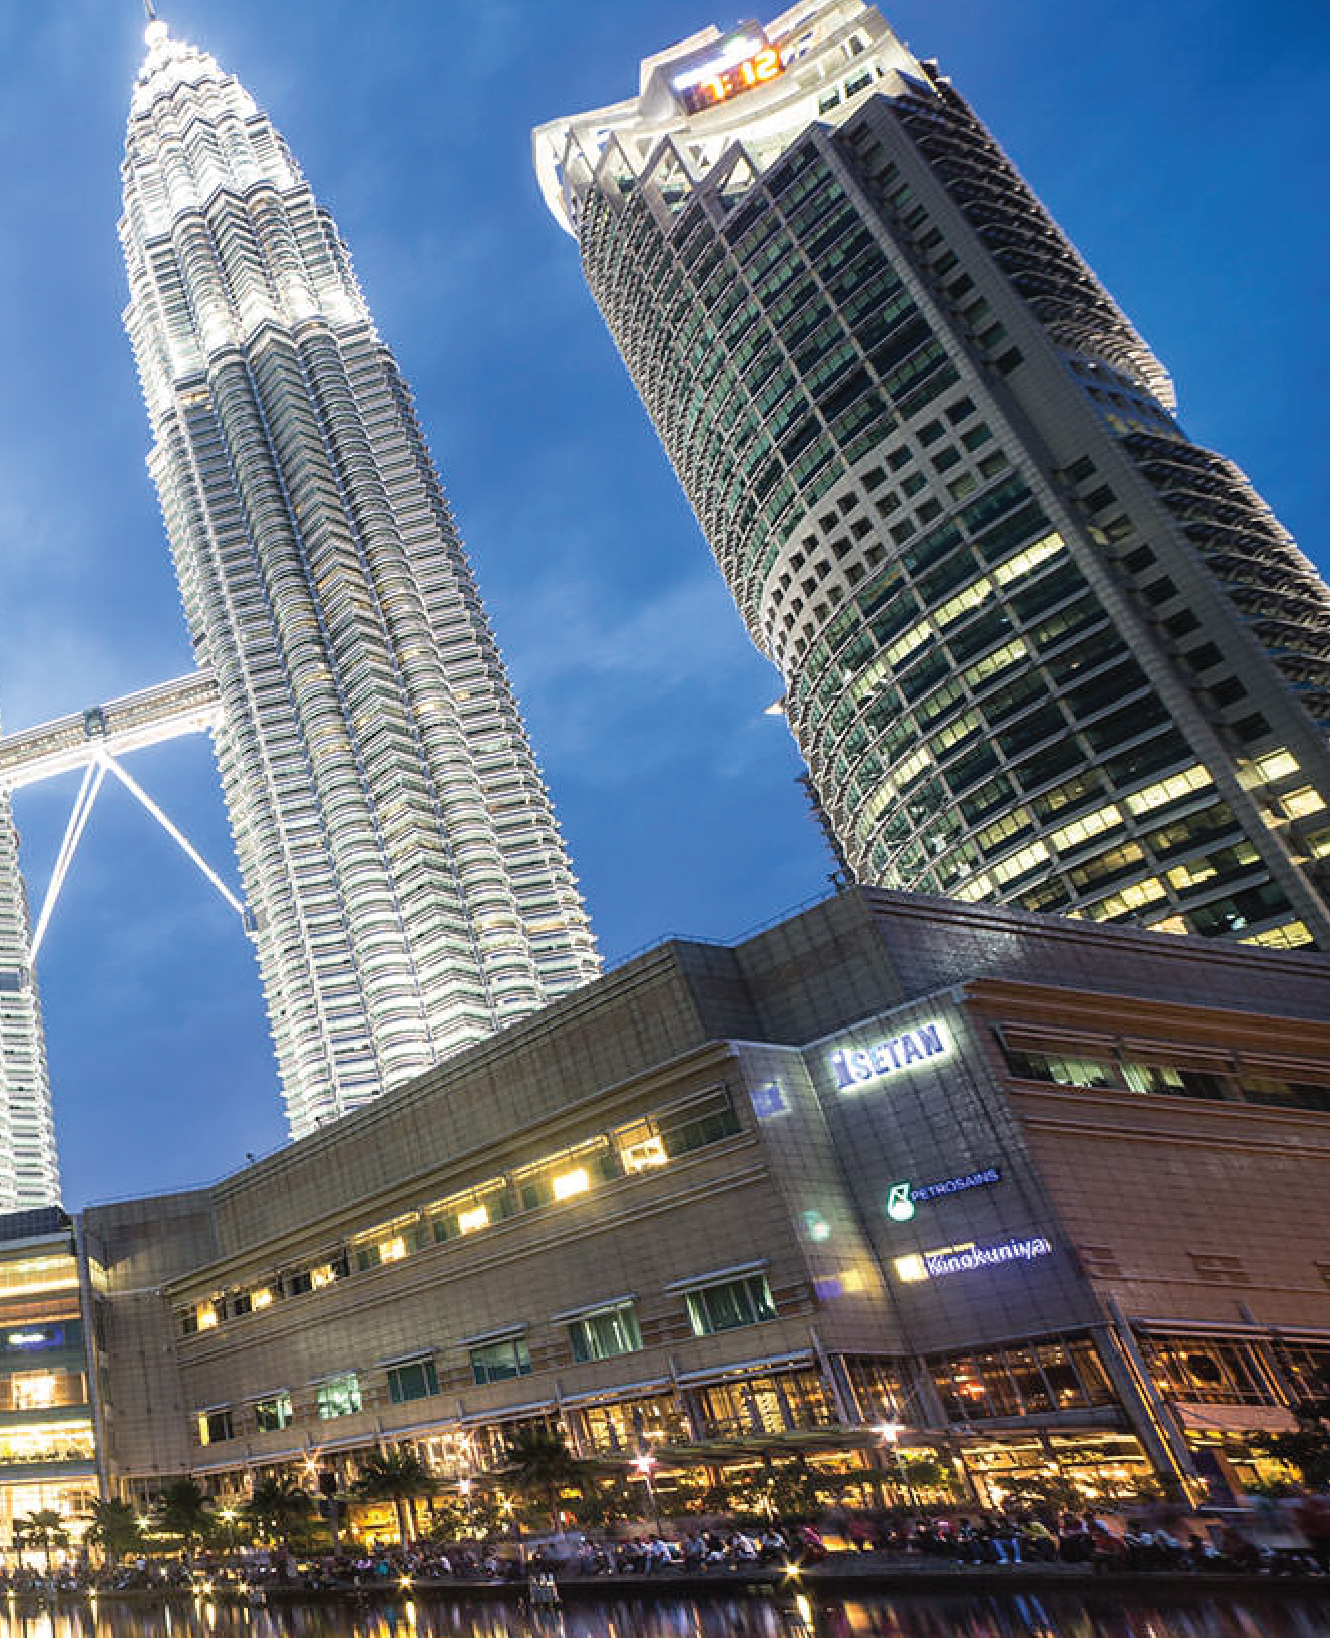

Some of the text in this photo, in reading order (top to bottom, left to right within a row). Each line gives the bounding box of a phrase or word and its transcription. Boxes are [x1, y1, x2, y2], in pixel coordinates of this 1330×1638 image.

[700, 49, 778, 100] 7:12
[911, 1168, 1000, 1201] PETROSAINS
[927, 1238, 1052, 1276] Kinokuniya
